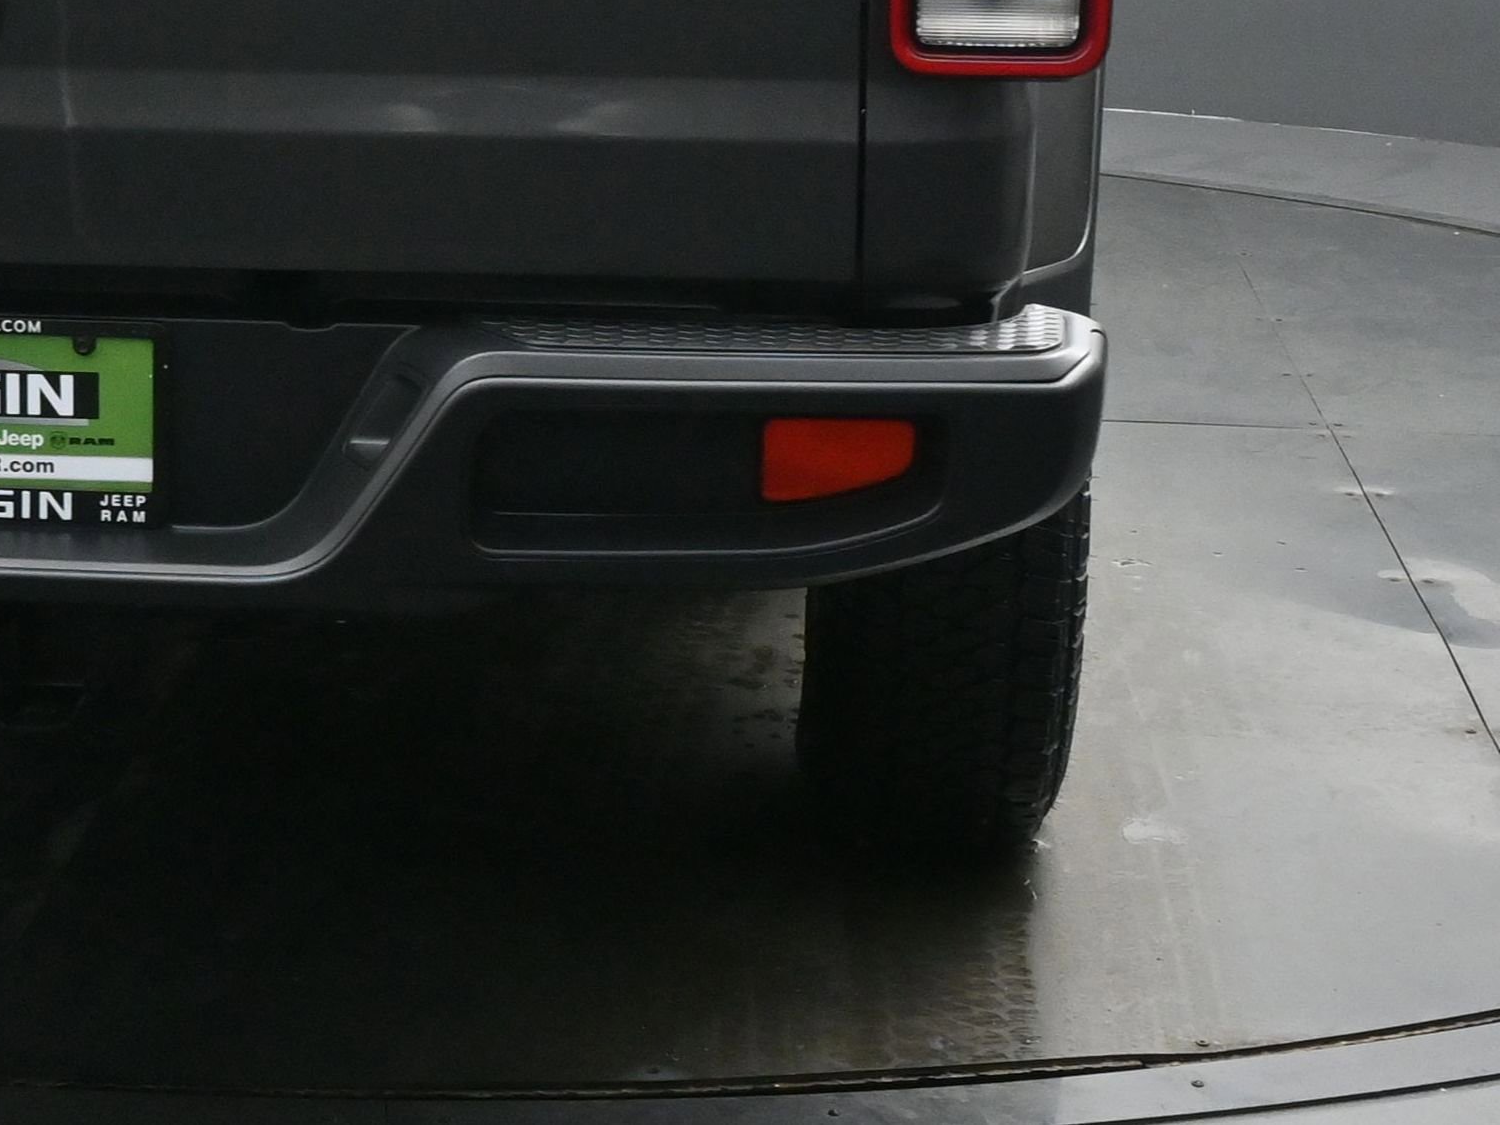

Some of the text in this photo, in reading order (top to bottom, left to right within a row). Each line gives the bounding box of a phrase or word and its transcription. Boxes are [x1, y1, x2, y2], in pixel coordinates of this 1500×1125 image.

[69, 437, 115, 446] RAM
[100, 495, 147, 507] JEEP
[100, 510, 146, 523] RAM
